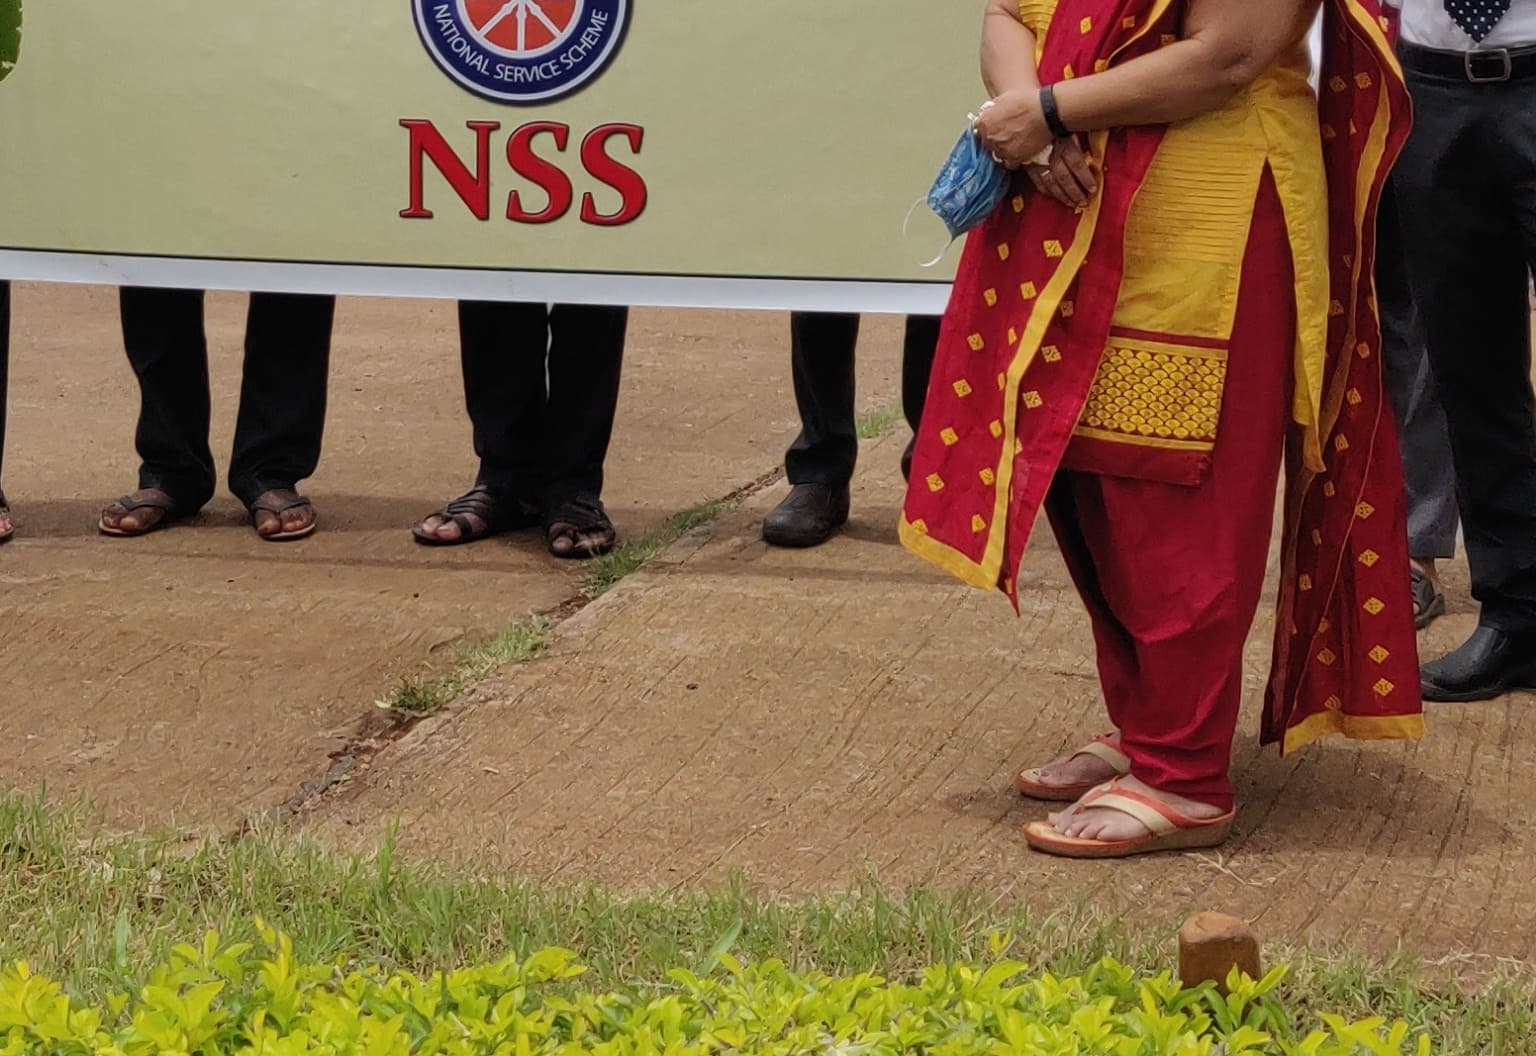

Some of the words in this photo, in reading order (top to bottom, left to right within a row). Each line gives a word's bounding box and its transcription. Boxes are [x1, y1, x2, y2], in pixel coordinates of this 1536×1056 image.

[433, 3, 490, 76] NATIONAL
[493, 59, 562, 83] SERVICE
[560, 9, 609, 70] SCHEME
[399, 118, 648, 227] NSS
